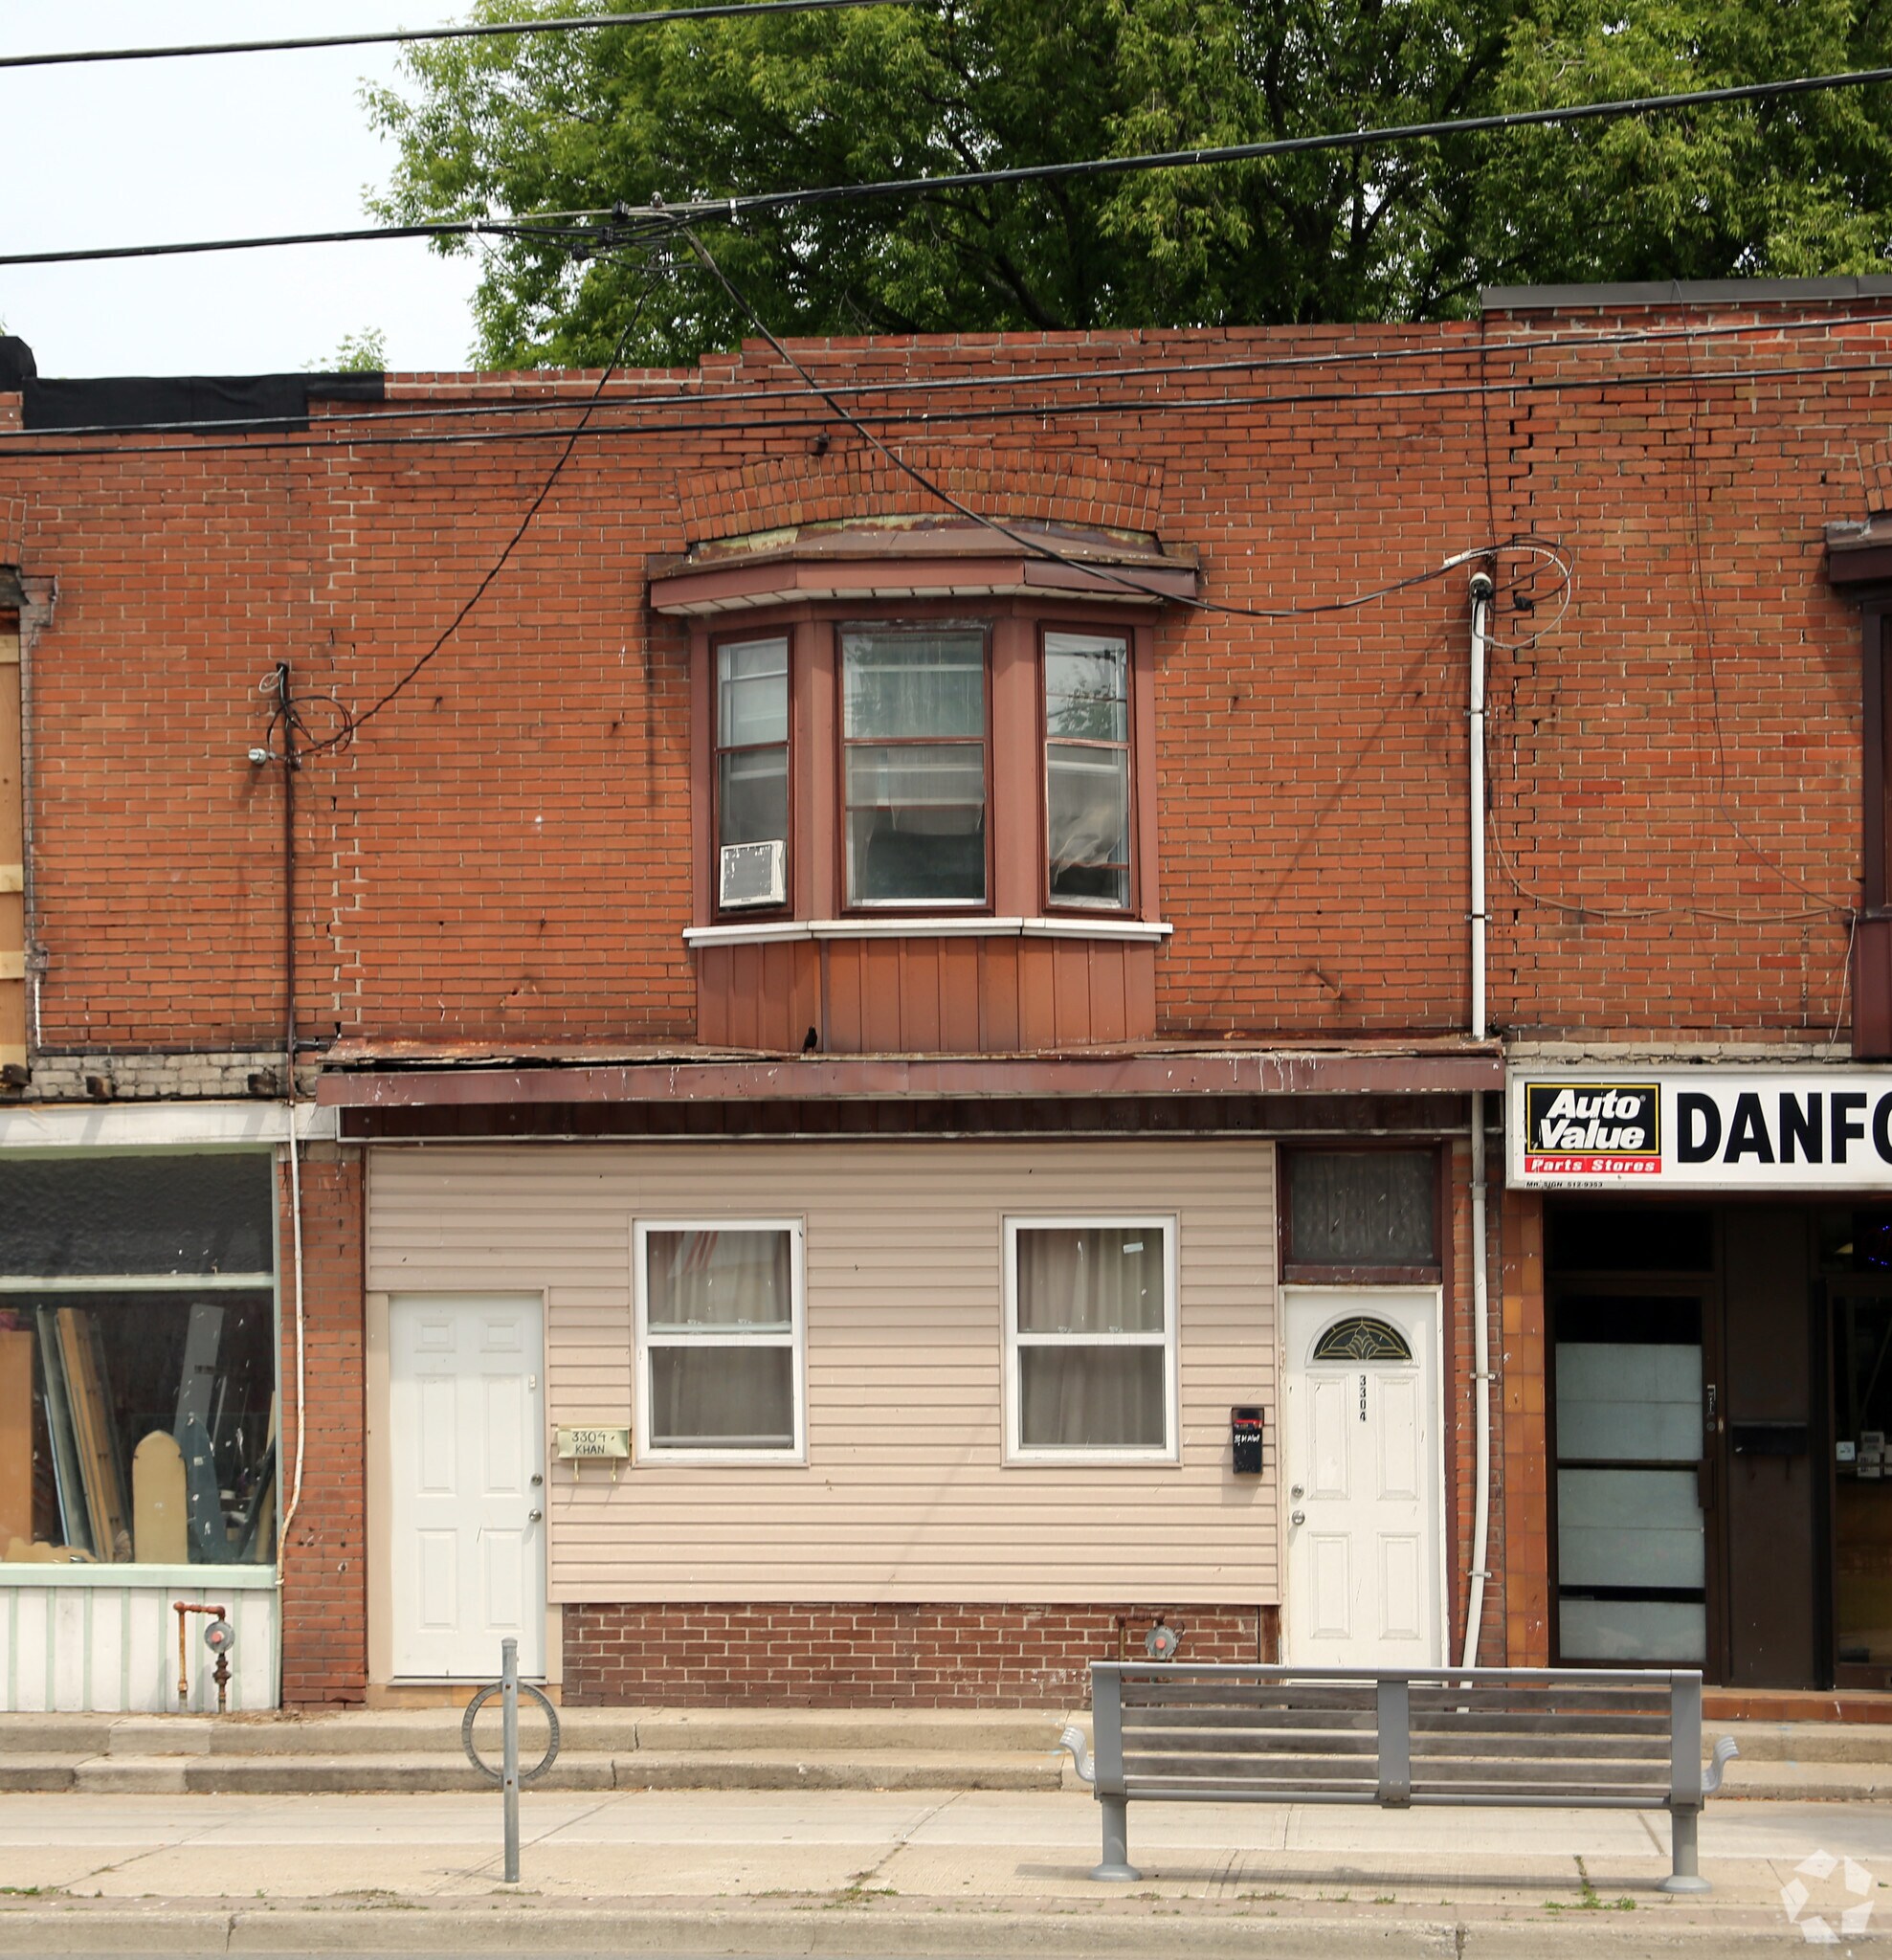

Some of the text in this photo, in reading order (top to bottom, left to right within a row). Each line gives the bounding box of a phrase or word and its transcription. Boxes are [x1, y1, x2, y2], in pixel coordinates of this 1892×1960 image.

[1546, 1088, 1641, 1120] Auto
[1540, 1119, 1645, 1149] Value
[1531, 1159, 1656, 1172] Parts Stores
[571, 1431, 606, 1442] 3304
[575, 1444, 605, 1454] KHAN
